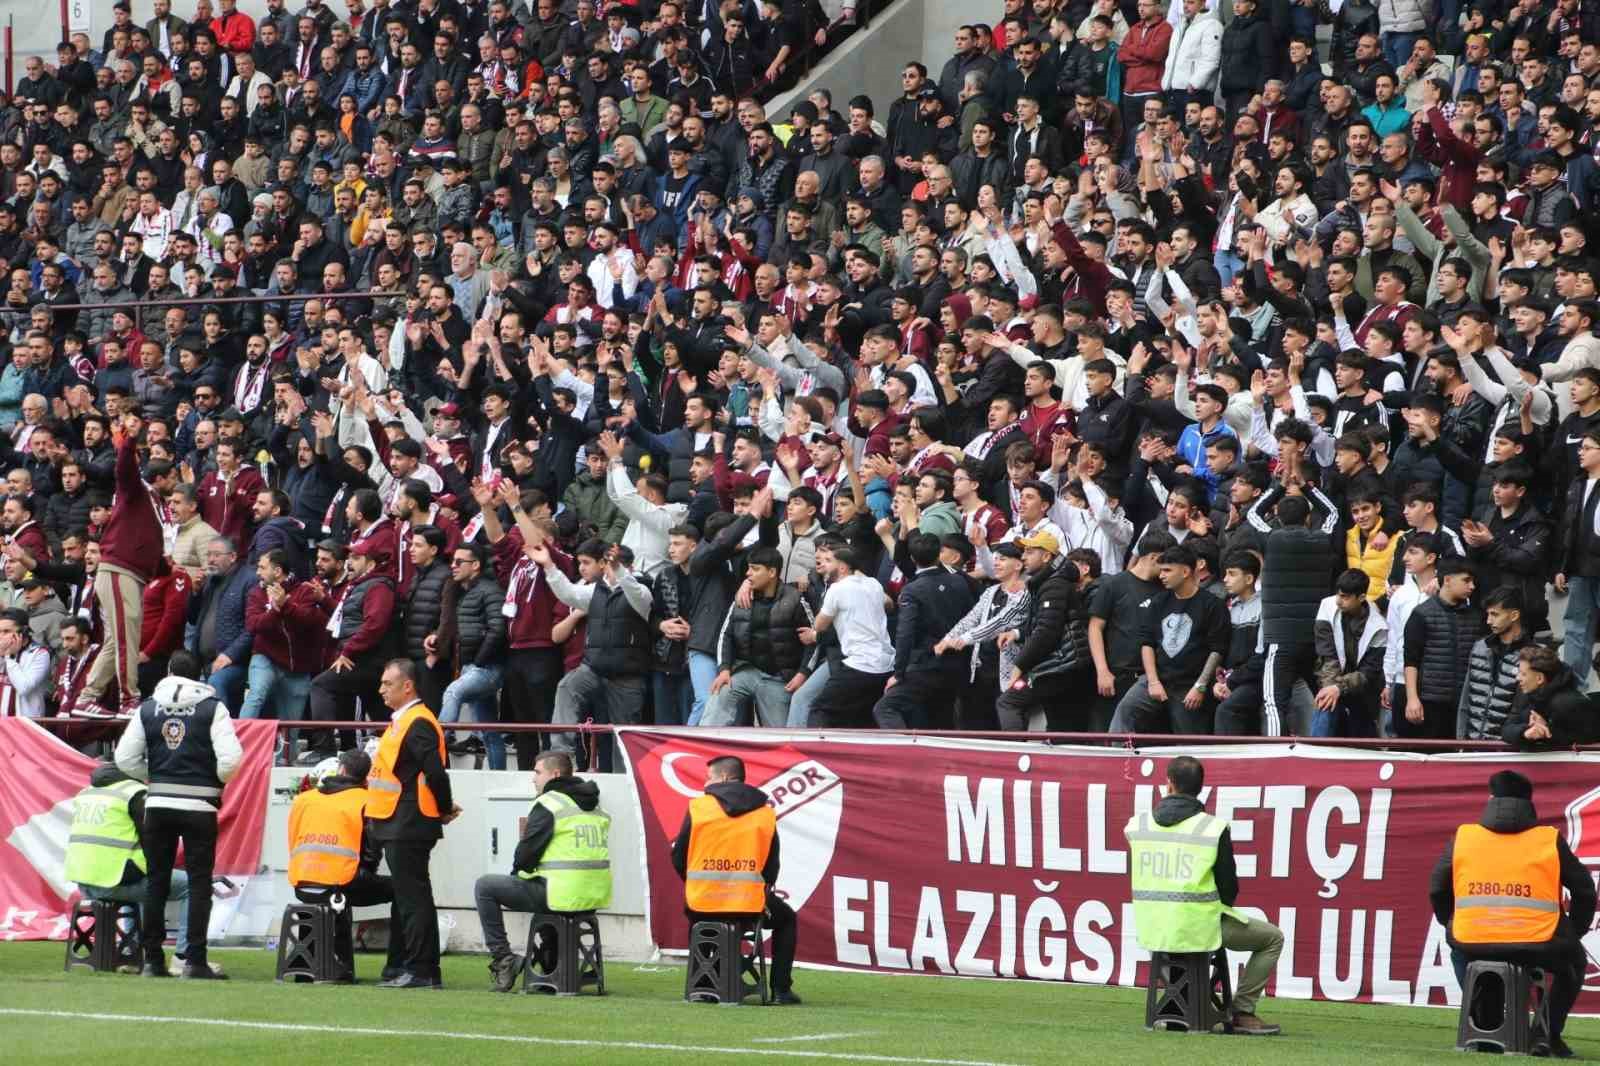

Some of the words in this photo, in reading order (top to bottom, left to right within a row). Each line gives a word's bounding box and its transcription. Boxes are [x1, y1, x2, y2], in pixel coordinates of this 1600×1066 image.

[74, 2, 82, 18] 6
[702, 858, 756, 871] 2380-079
[1139, 848, 1194, 880] POLİS
[1467, 882, 1532, 897] 2380-083
